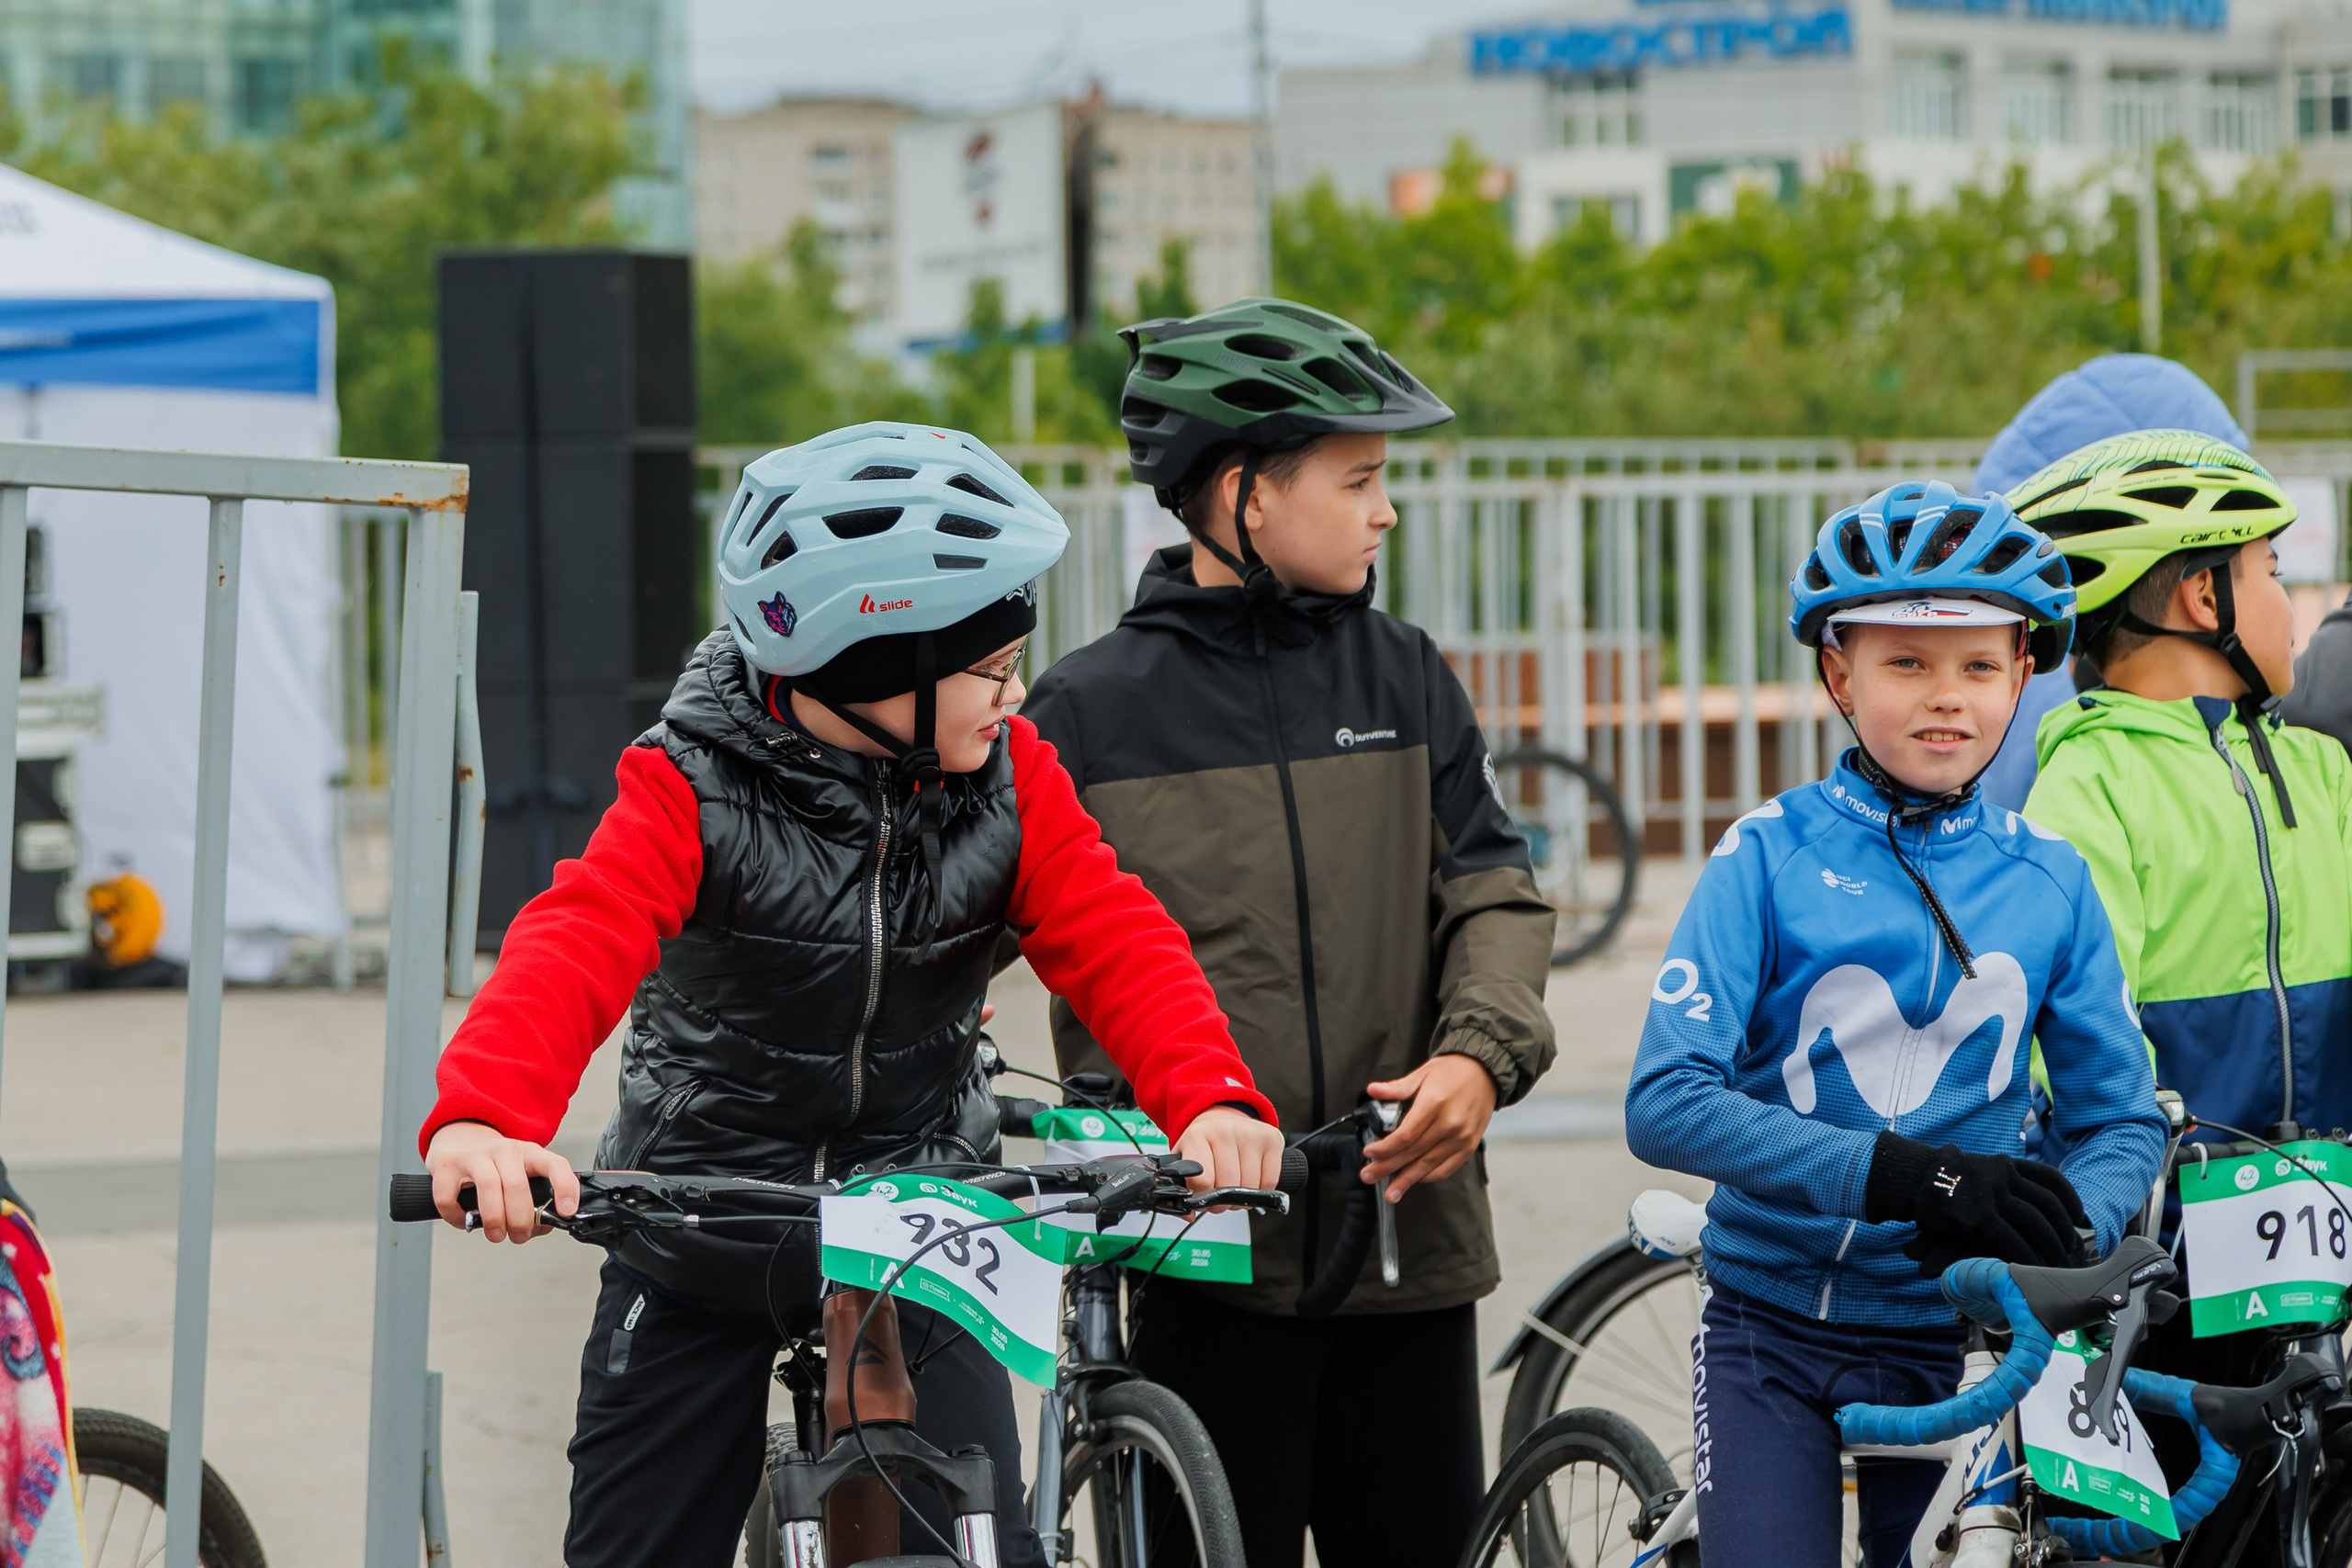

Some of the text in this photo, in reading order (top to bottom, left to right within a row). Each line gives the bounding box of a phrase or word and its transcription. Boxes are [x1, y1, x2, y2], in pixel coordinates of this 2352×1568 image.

[879, 599, 912, 613] slide
[1839, 881, 1868, 889] WORLD
[1841, 886, 1864, 896] TOUR
[731, 1177, 796, 1190] MERIDA
[940, 1183, 978, 1209] Звук
[2256, 1203, 2346, 1262] 918
[899, 1213, 1001, 1296] 932
[990, 1334, 1006, 1351] 2026
[2068, 1381, 2132, 1453] 89
